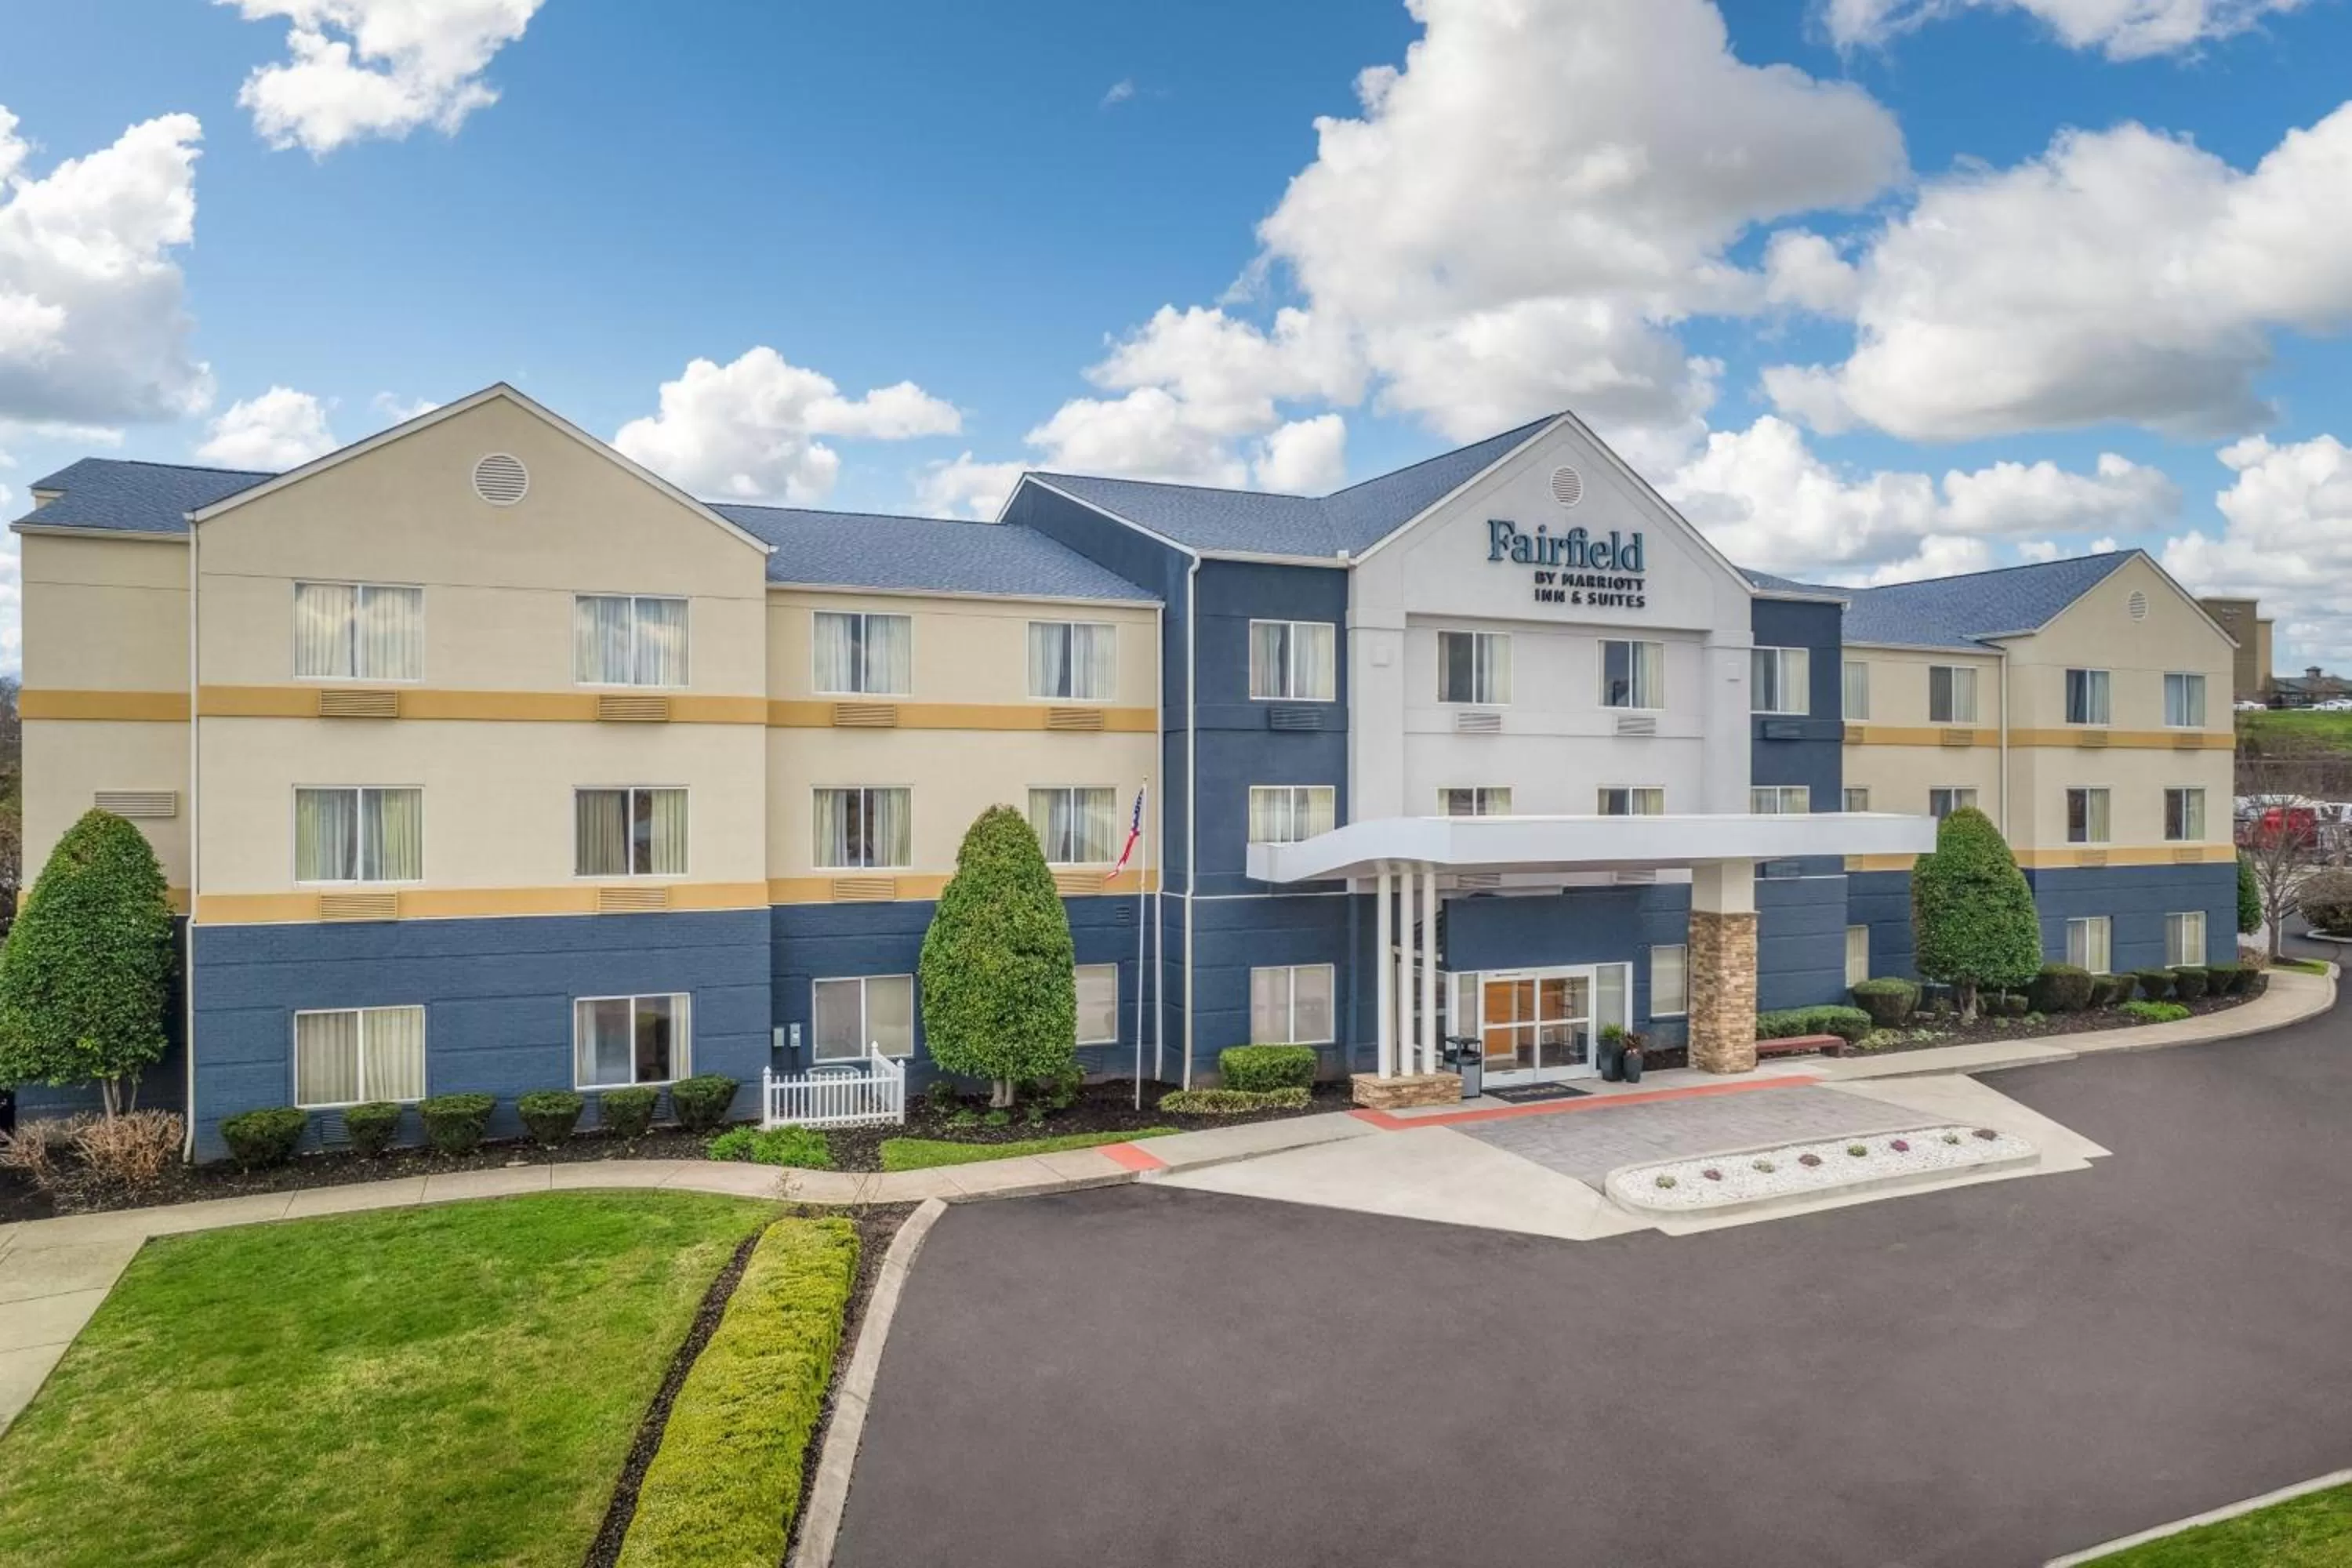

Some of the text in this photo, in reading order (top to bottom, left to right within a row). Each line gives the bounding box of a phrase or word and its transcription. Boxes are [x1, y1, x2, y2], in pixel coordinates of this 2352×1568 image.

[1487, 519, 1646, 572] Fairfield
[1534, 571, 1646, 591] BY MARRIOTT
[1534, 589, 1646, 608] INN & SUITES
